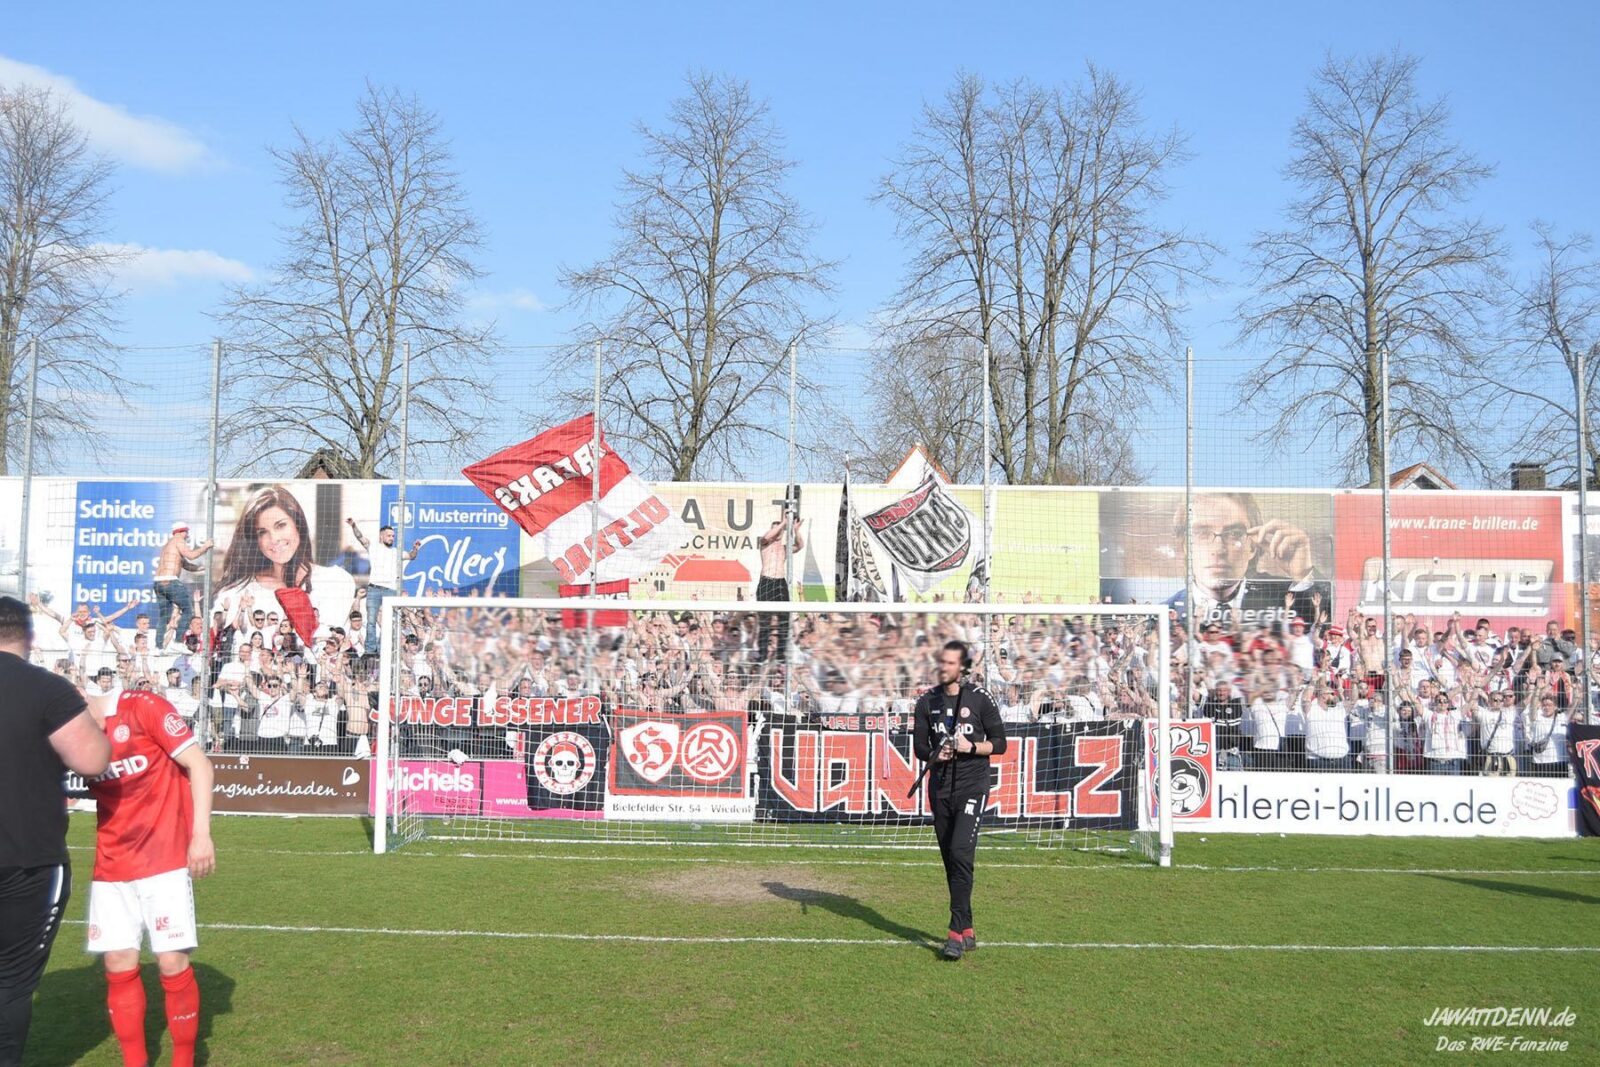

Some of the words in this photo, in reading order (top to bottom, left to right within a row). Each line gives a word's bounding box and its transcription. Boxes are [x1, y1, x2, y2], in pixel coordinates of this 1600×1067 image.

[79, 499, 154, 519] Schicke
[418, 507, 509, 527] Musterring
[1389, 515, 1539, 532] www.krane-brillen.de
[77, 555, 145, 575] finden
[75, 583, 108, 603] bei
[114, 587, 158, 604] uns!
[1364, 566, 1546, 605] krane
[369, 696, 472, 727] UNGE
[770, 729, 1123, 818] VANALZ
[612, 803, 664, 813] Bielefelder
[668, 803, 684, 813] Str.
[689, 803, 701, 813] 54
[1217, 784, 1497, 825] hlerei-billen.de
